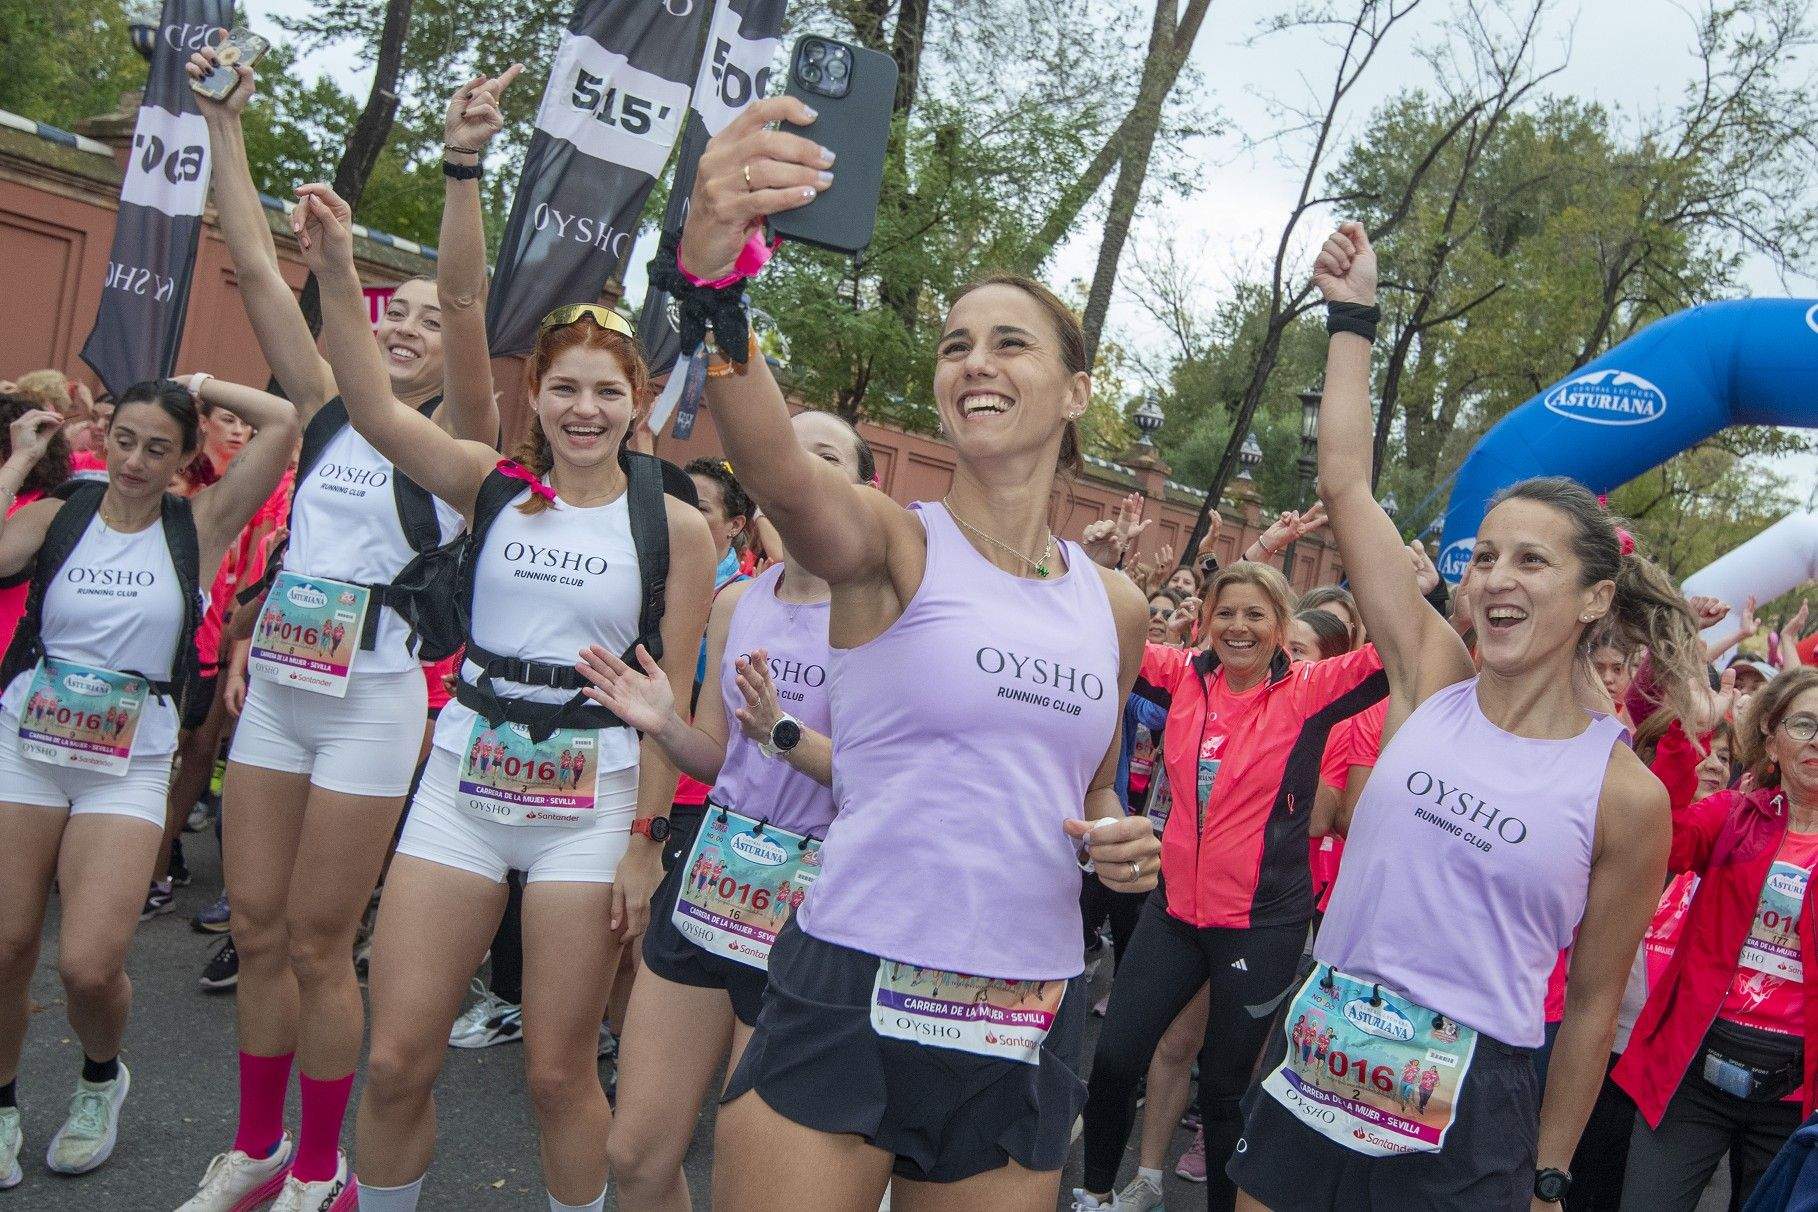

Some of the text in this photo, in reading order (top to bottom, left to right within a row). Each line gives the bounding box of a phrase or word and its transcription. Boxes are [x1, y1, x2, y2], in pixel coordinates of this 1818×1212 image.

[572, 68, 671, 134] 515'
[1551, 387, 1654, 416] ASTURIANA
[319, 463, 387, 488] OYSHO
[321, 483, 366, 498] RUNNING CLUB
[503, 541, 608, 576] OYSHO
[67, 567, 155, 587] OYSHO
[513, 569, 584, 587] RUNNING CLUB
[77, 588, 138, 598] RUNNING CLUB
[281, 623, 318, 645] 016
[310, 661, 332, 672] SEVILLA
[736, 653, 826, 688] SHO
[976, 646, 1104, 701] OYSHO
[297, 674, 332, 687] Santander
[781, 690, 805, 702] CLUB
[997, 686, 1082, 717] RUNNING CLUB
[57, 708, 101, 730] 016
[22, 742, 57, 758] OYSHO
[79, 755, 113, 768] Santander
[504, 757, 556, 781] 016
[475, 786, 576, 805] CARRERA DE LA MUJER SEVILLA
[469, 800, 511, 816] OYSHO
[537, 812, 579, 822] Santander
[1406, 771, 1527, 845] OYSHO
[1414, 807, 1493, 853] RUNNING CLUB
[732, 837, 783, 864] ASTURIANA
[718, 877, 771, 910] 016
[1769, 876, 1803, 895] ASTURI
[690, 906, 776, 943] CARRERA DE LA MUJER SEVI
[729, 908, 741, 920] 16
[682, 920, 714, 942] OYSHO
[1772, 935, 1789, 946] 177
[1740, 950, 1764, 964] SHO
[1776, 946, 1798, 958] MUJER
[904, 998, 948, 1014] CARRERA
[950, 1004, 963, 1016] DE
[965, 1006, 977, 1018] LA
[1011, 1011, 1045, 1024] SEVILLA
[896, 1017, 961, 1040] OYSHO
[1347, 1006, 1409, 1040] ASTURIANA
[1328, 1051, 1395, 1093] 016
[1286, 1088, 1335, 1124] OYSHO
[1352, 1089, 1360, 1101] 2
[1355, 1104, 1380, 1122] MUJER
[1387, 1117, 1420, 1135] SEVILLA
[1366, 1132, 1419, 1153] Santand
[317, 1180, 344, 1212] OKA
